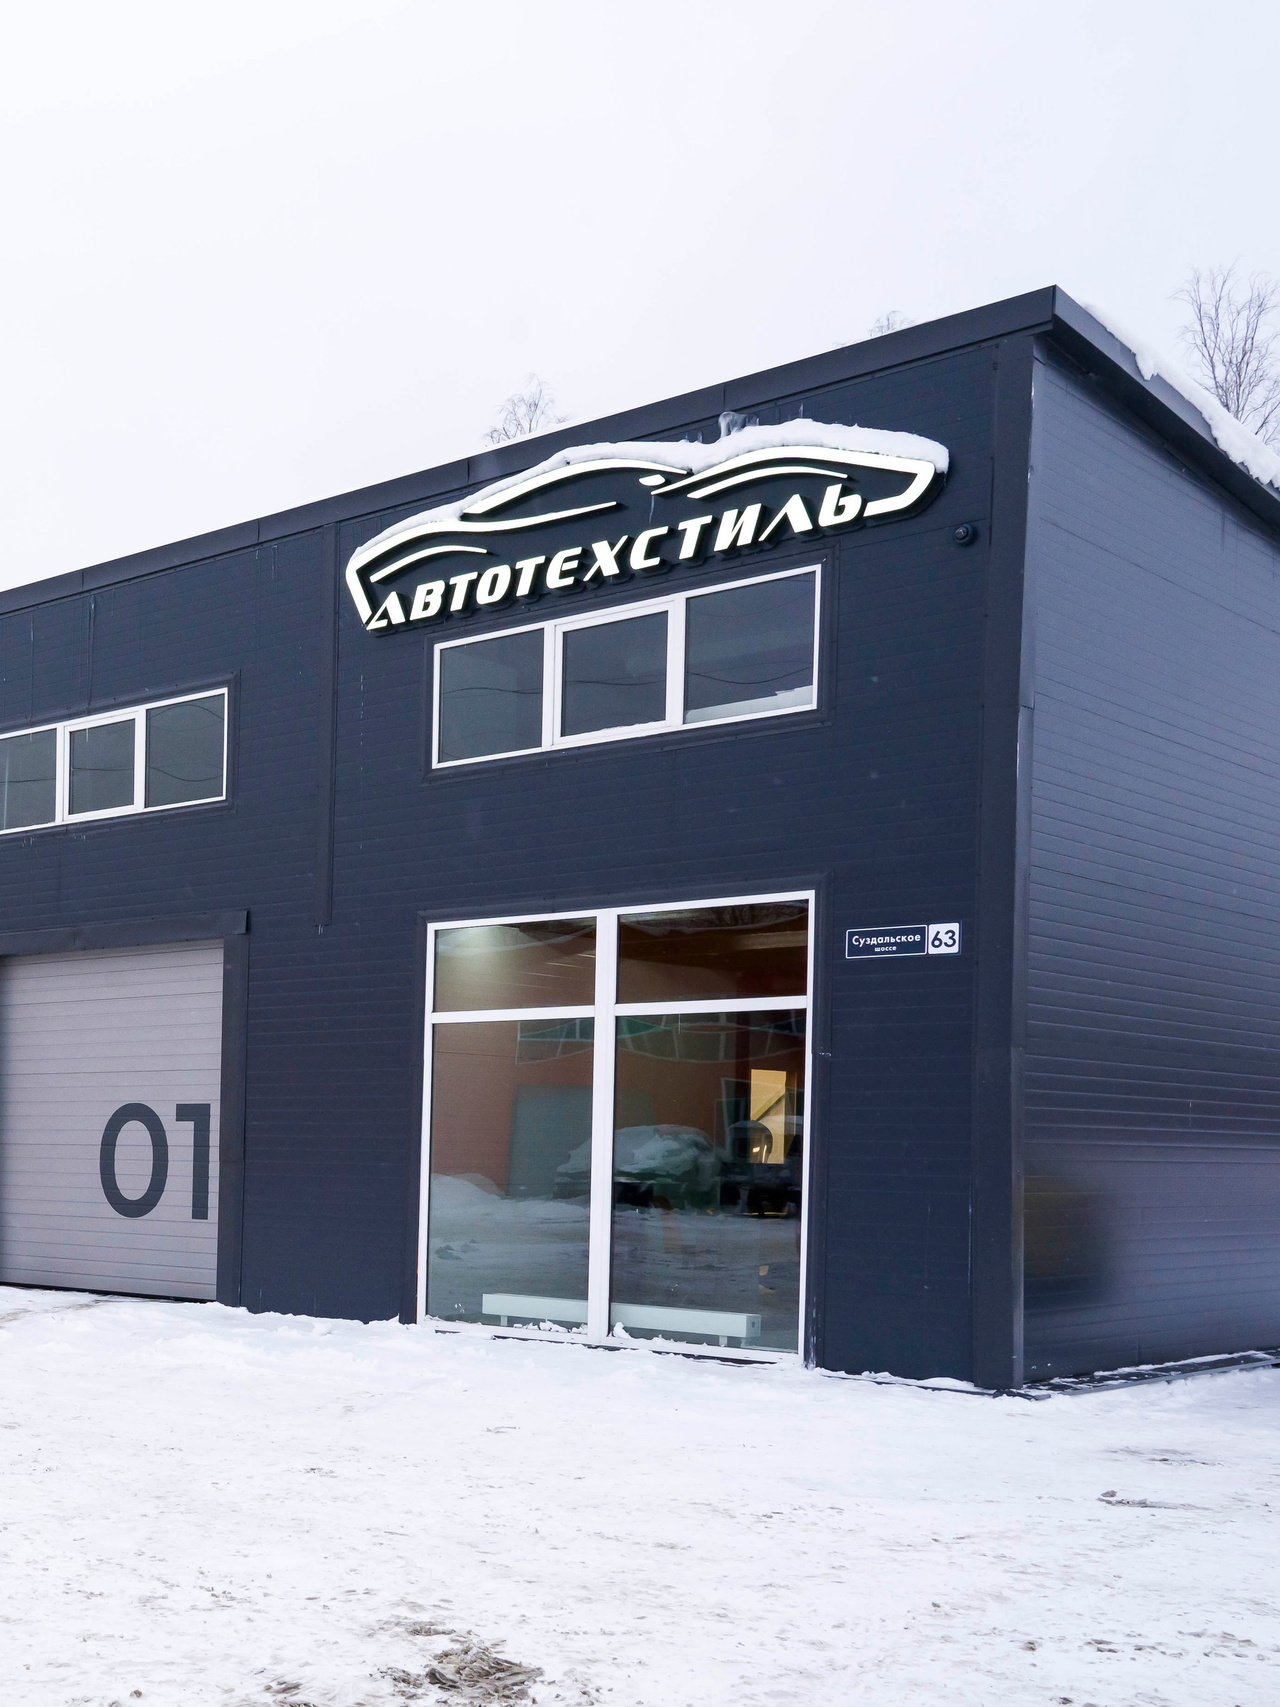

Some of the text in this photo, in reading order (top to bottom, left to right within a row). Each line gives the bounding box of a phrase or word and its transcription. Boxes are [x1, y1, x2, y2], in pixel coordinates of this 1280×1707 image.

[366, 484, 864, 631] АВТОТЕХСТИЛЬ
[852, 934, 921, 948] Суздальское
[930, 929, 957, 949] 63
[99, 1102, 211, 1220] 01
